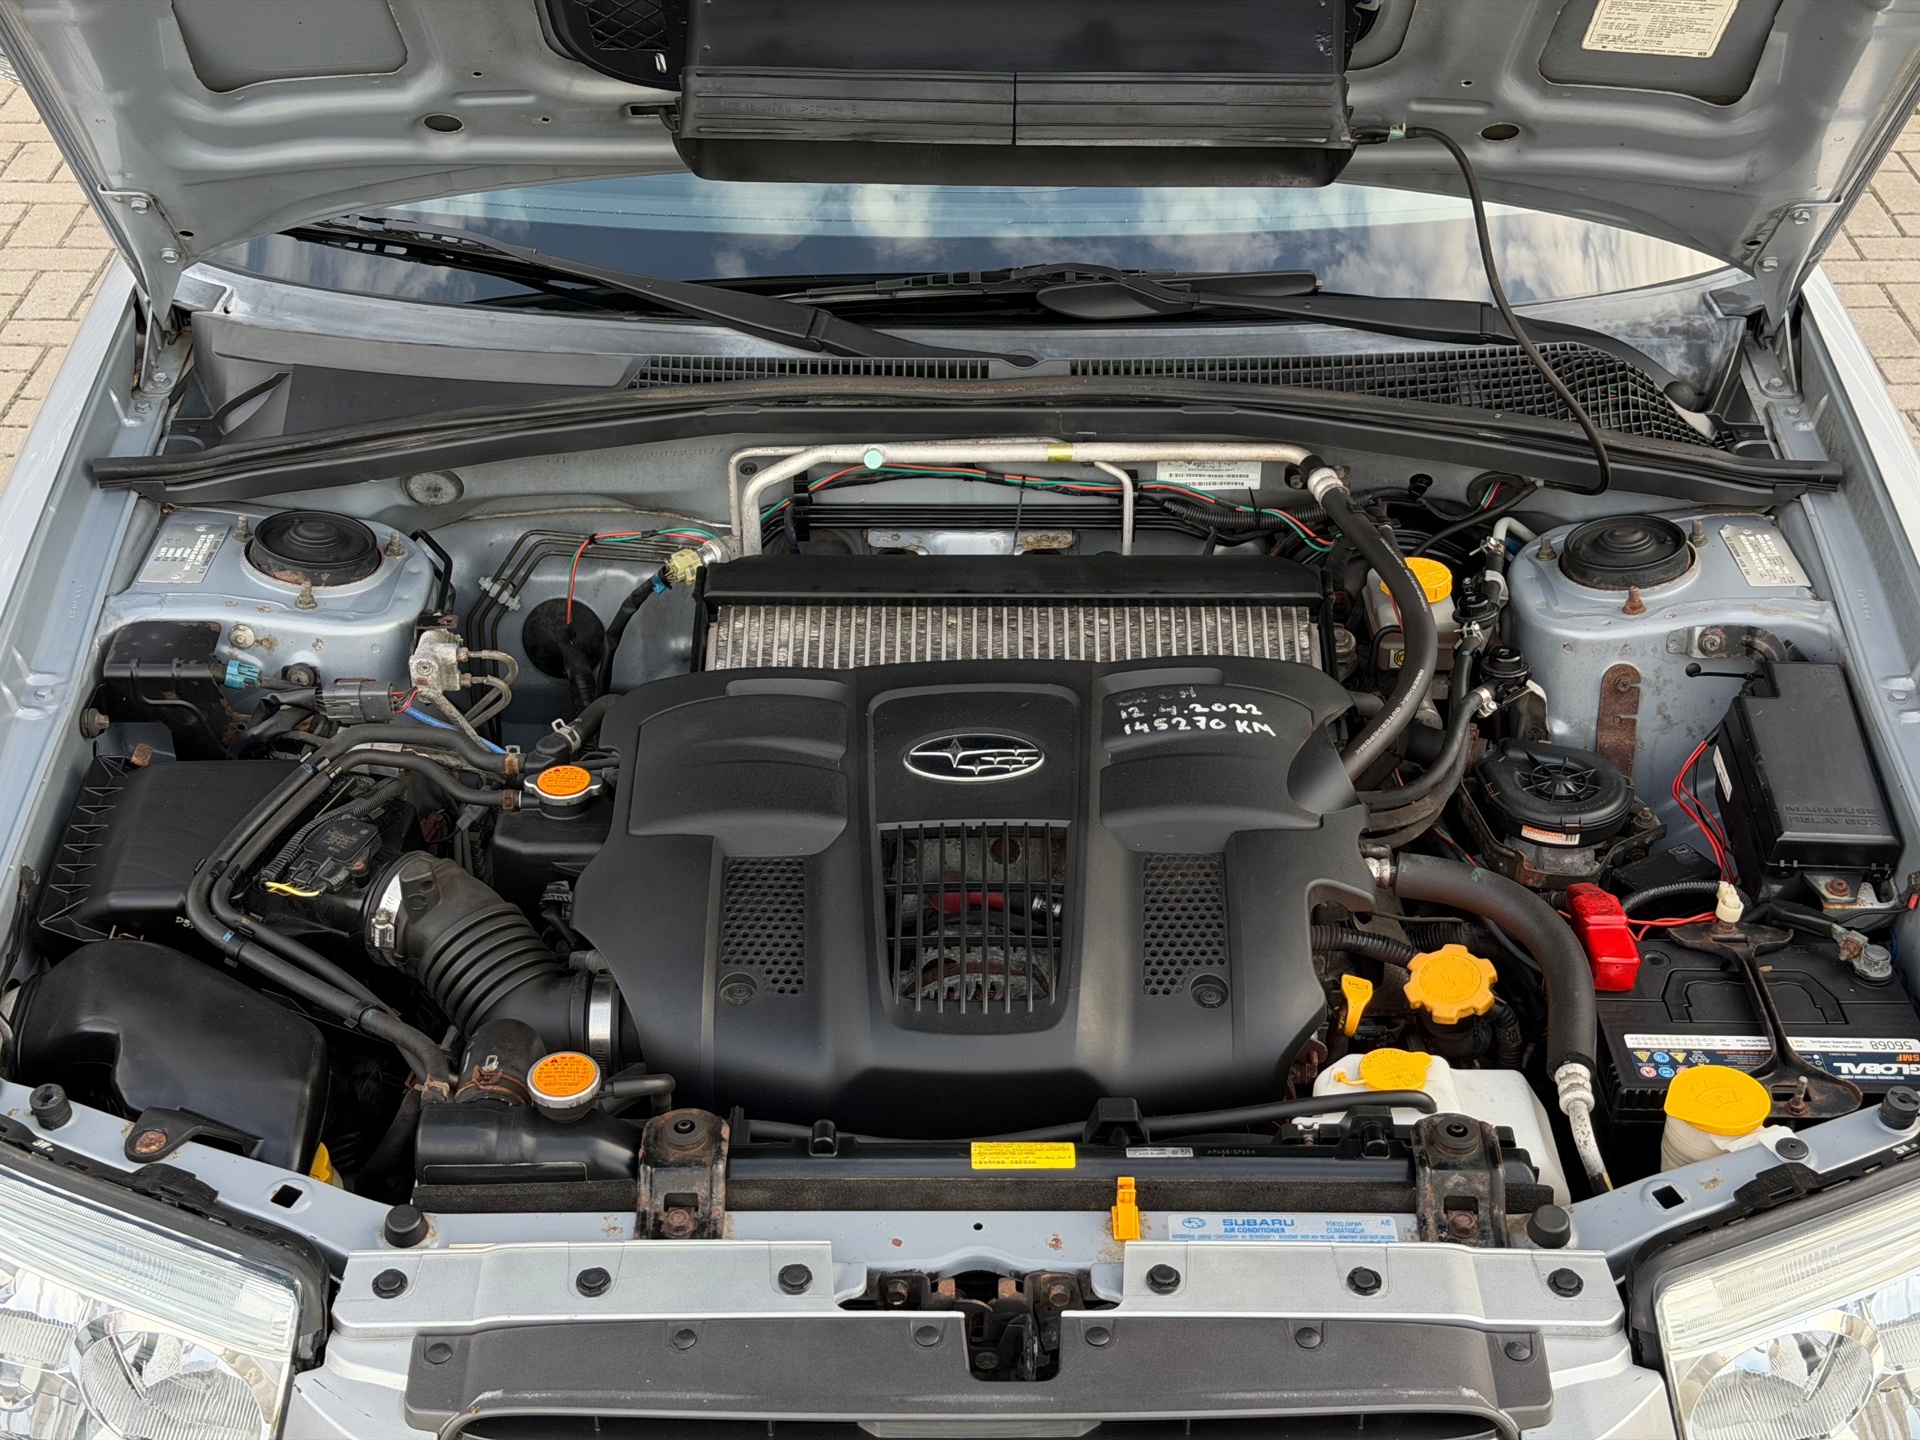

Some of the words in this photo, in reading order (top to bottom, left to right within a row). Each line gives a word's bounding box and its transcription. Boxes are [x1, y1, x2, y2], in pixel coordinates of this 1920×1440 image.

[1124, 716, 1227, 735] 145270
[1235, 719, 1277, 737] KM
[1784, 805, 1831, 814] MAIN
[1833, 806, 1878, 815] FUSE
[1788, 816, 1839, 825] RELAY
[1845, 818, 1881, 826] BOX
[1869, 1039, 1912, 1051] 56068
[1896, 1054, 1920, 1062] SMF
[1832, 1063, 1920, 1075] GLOBAL
[1221, 1218, 1295, 1227] SUBARU
